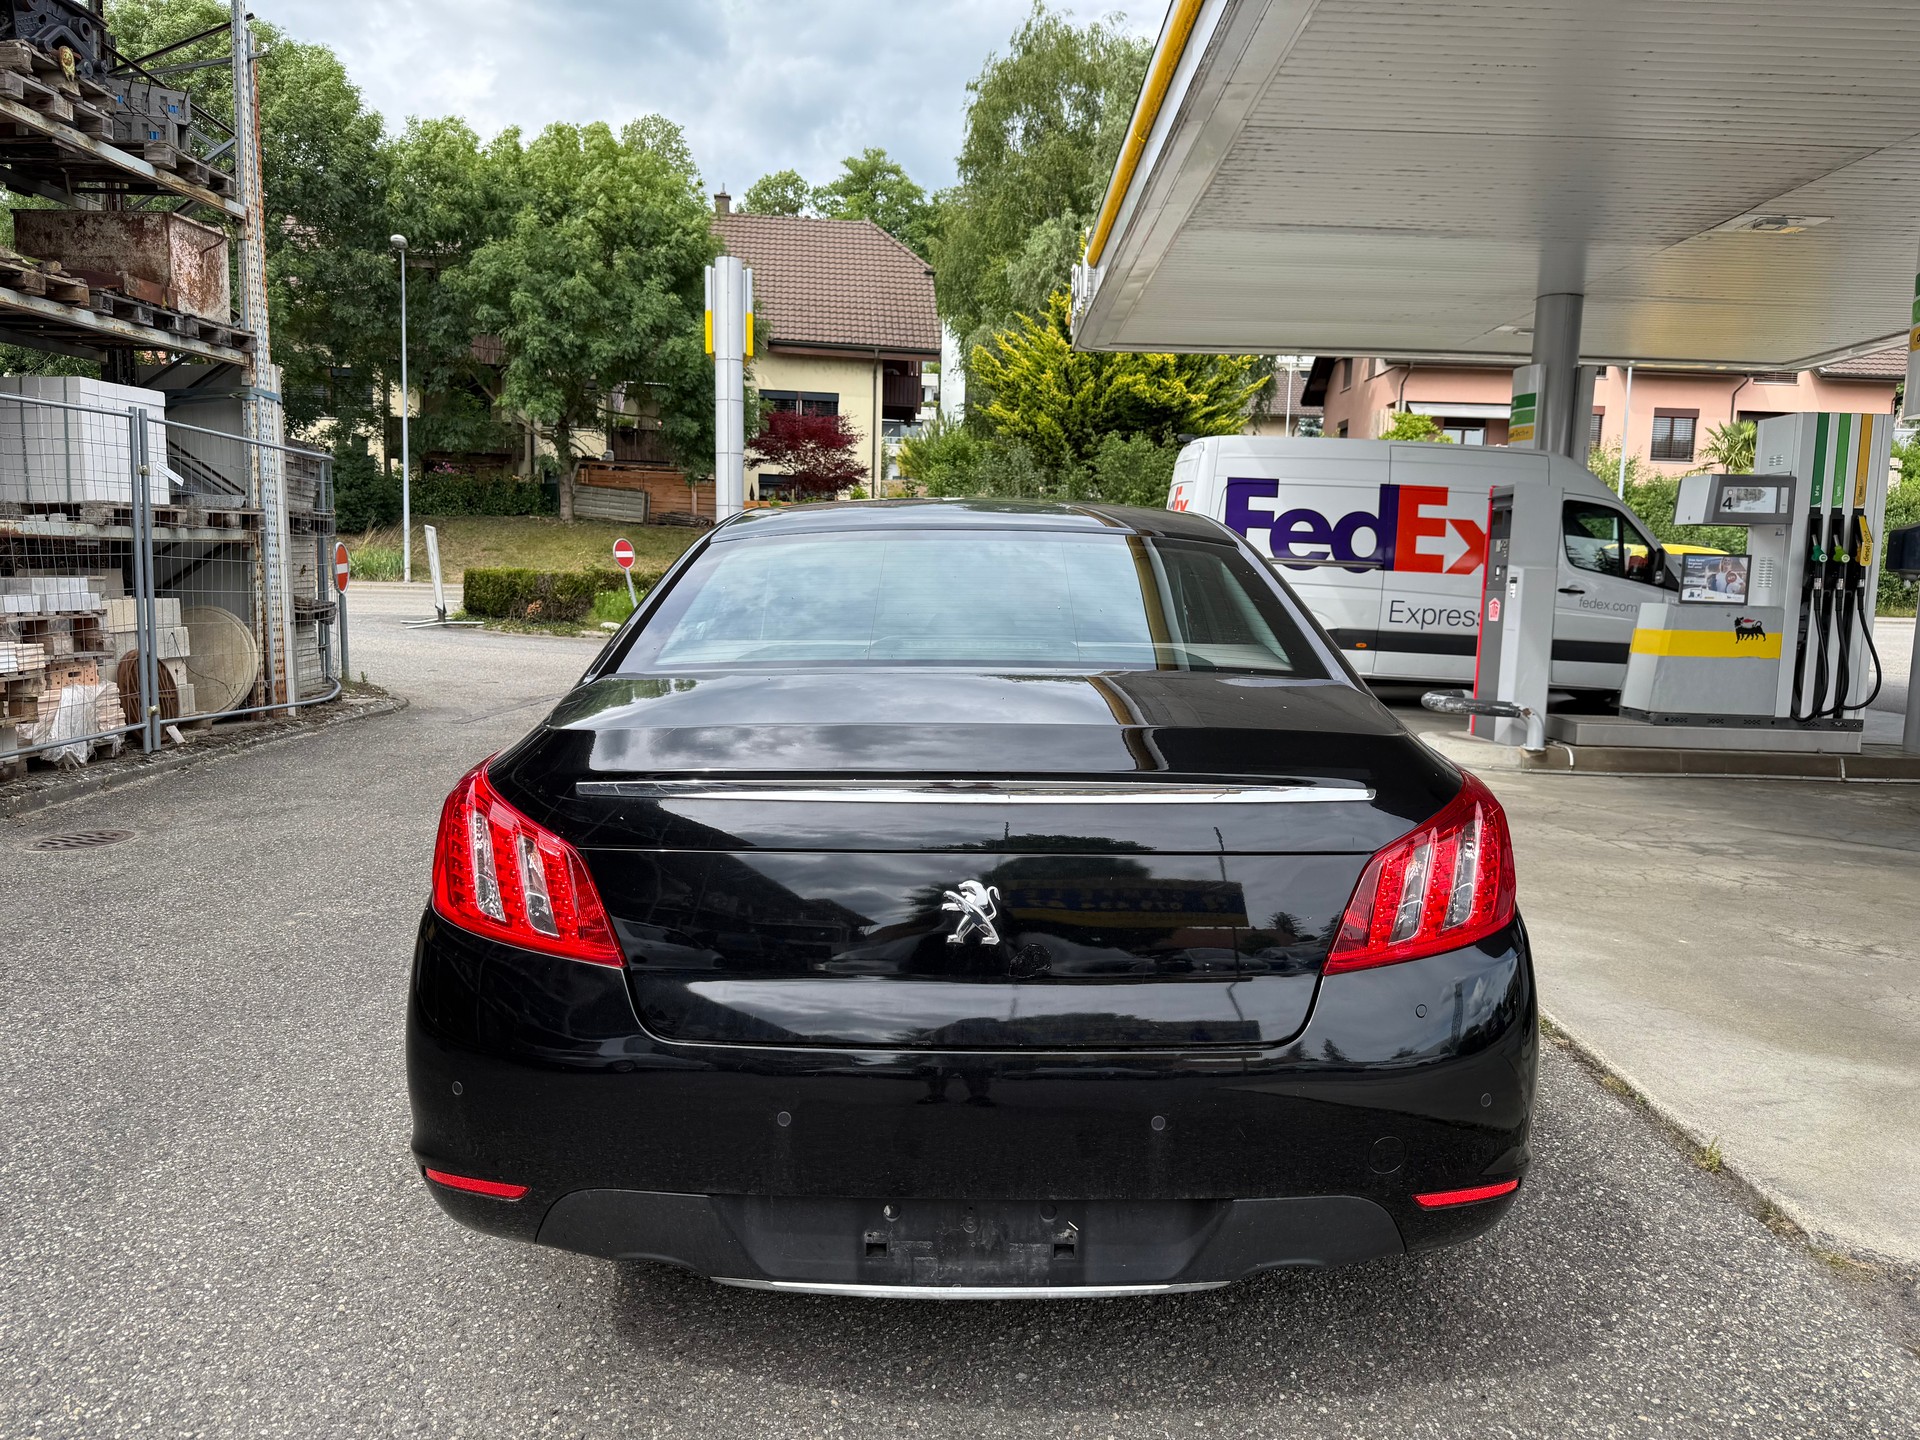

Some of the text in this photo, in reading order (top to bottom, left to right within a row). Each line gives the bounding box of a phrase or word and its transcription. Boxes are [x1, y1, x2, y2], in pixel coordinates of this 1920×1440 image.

[1722, 497, 1733, 510] 4
[1225, 477, 1486, 575] FedEx
[1389, 600, 1480, 630] Expres
[1579, 597, 1638, 613] fedex.com
